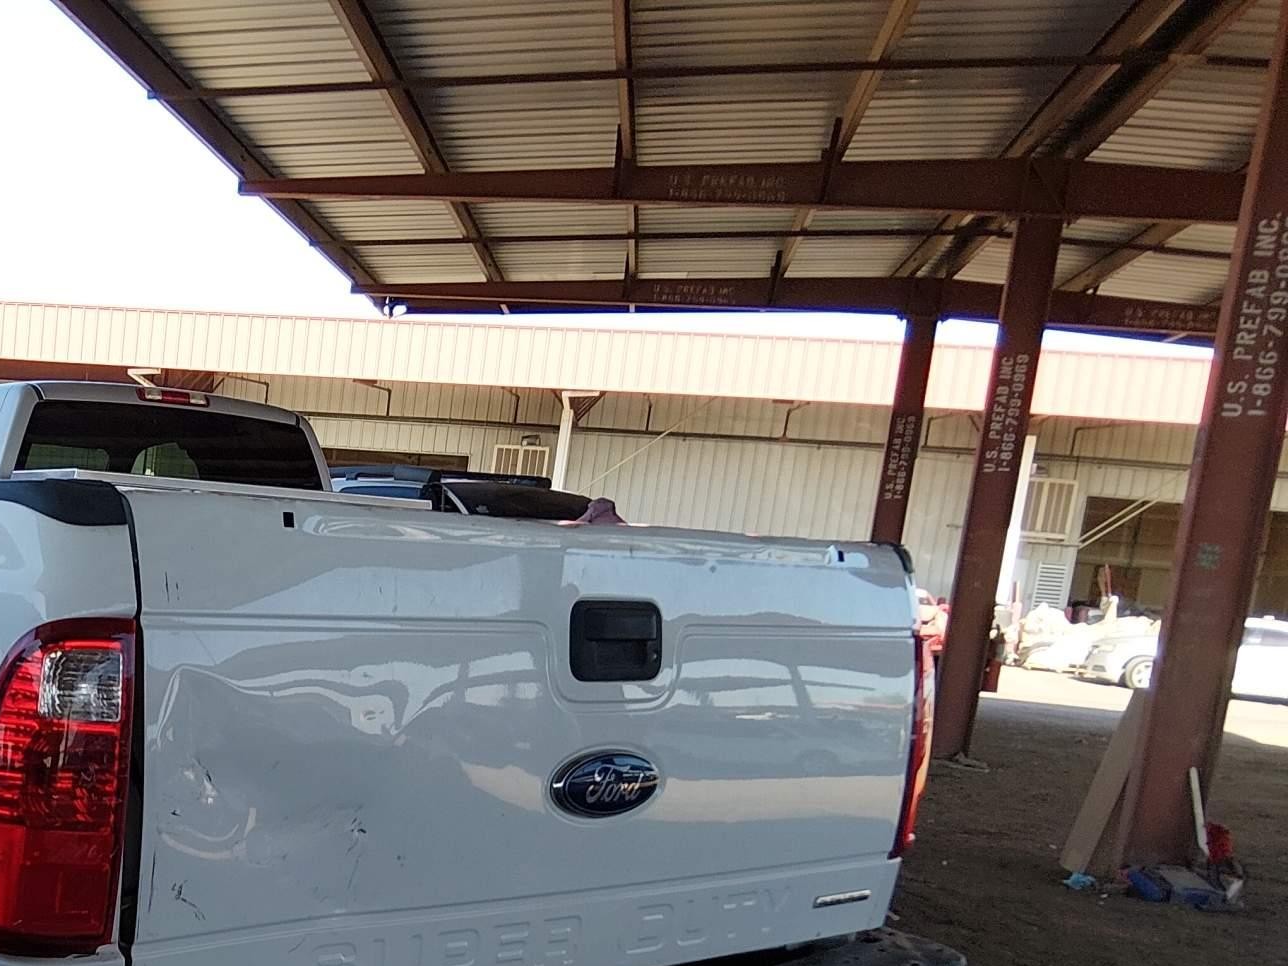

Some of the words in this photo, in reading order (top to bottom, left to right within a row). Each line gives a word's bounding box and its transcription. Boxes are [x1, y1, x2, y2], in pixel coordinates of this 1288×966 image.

[1253, 212, 1283, 256] INC.
[1233, 268, 1270, 361] PREFAB
[988, 385, 1010, 440] PREFAB
[998, 353, 1030, 472] 1-866-799-0969
[1221, 374, 1250, 417] U.S.
[585, 763, 644, 804] Ford
[618, 889, 791, 955] DUTY
